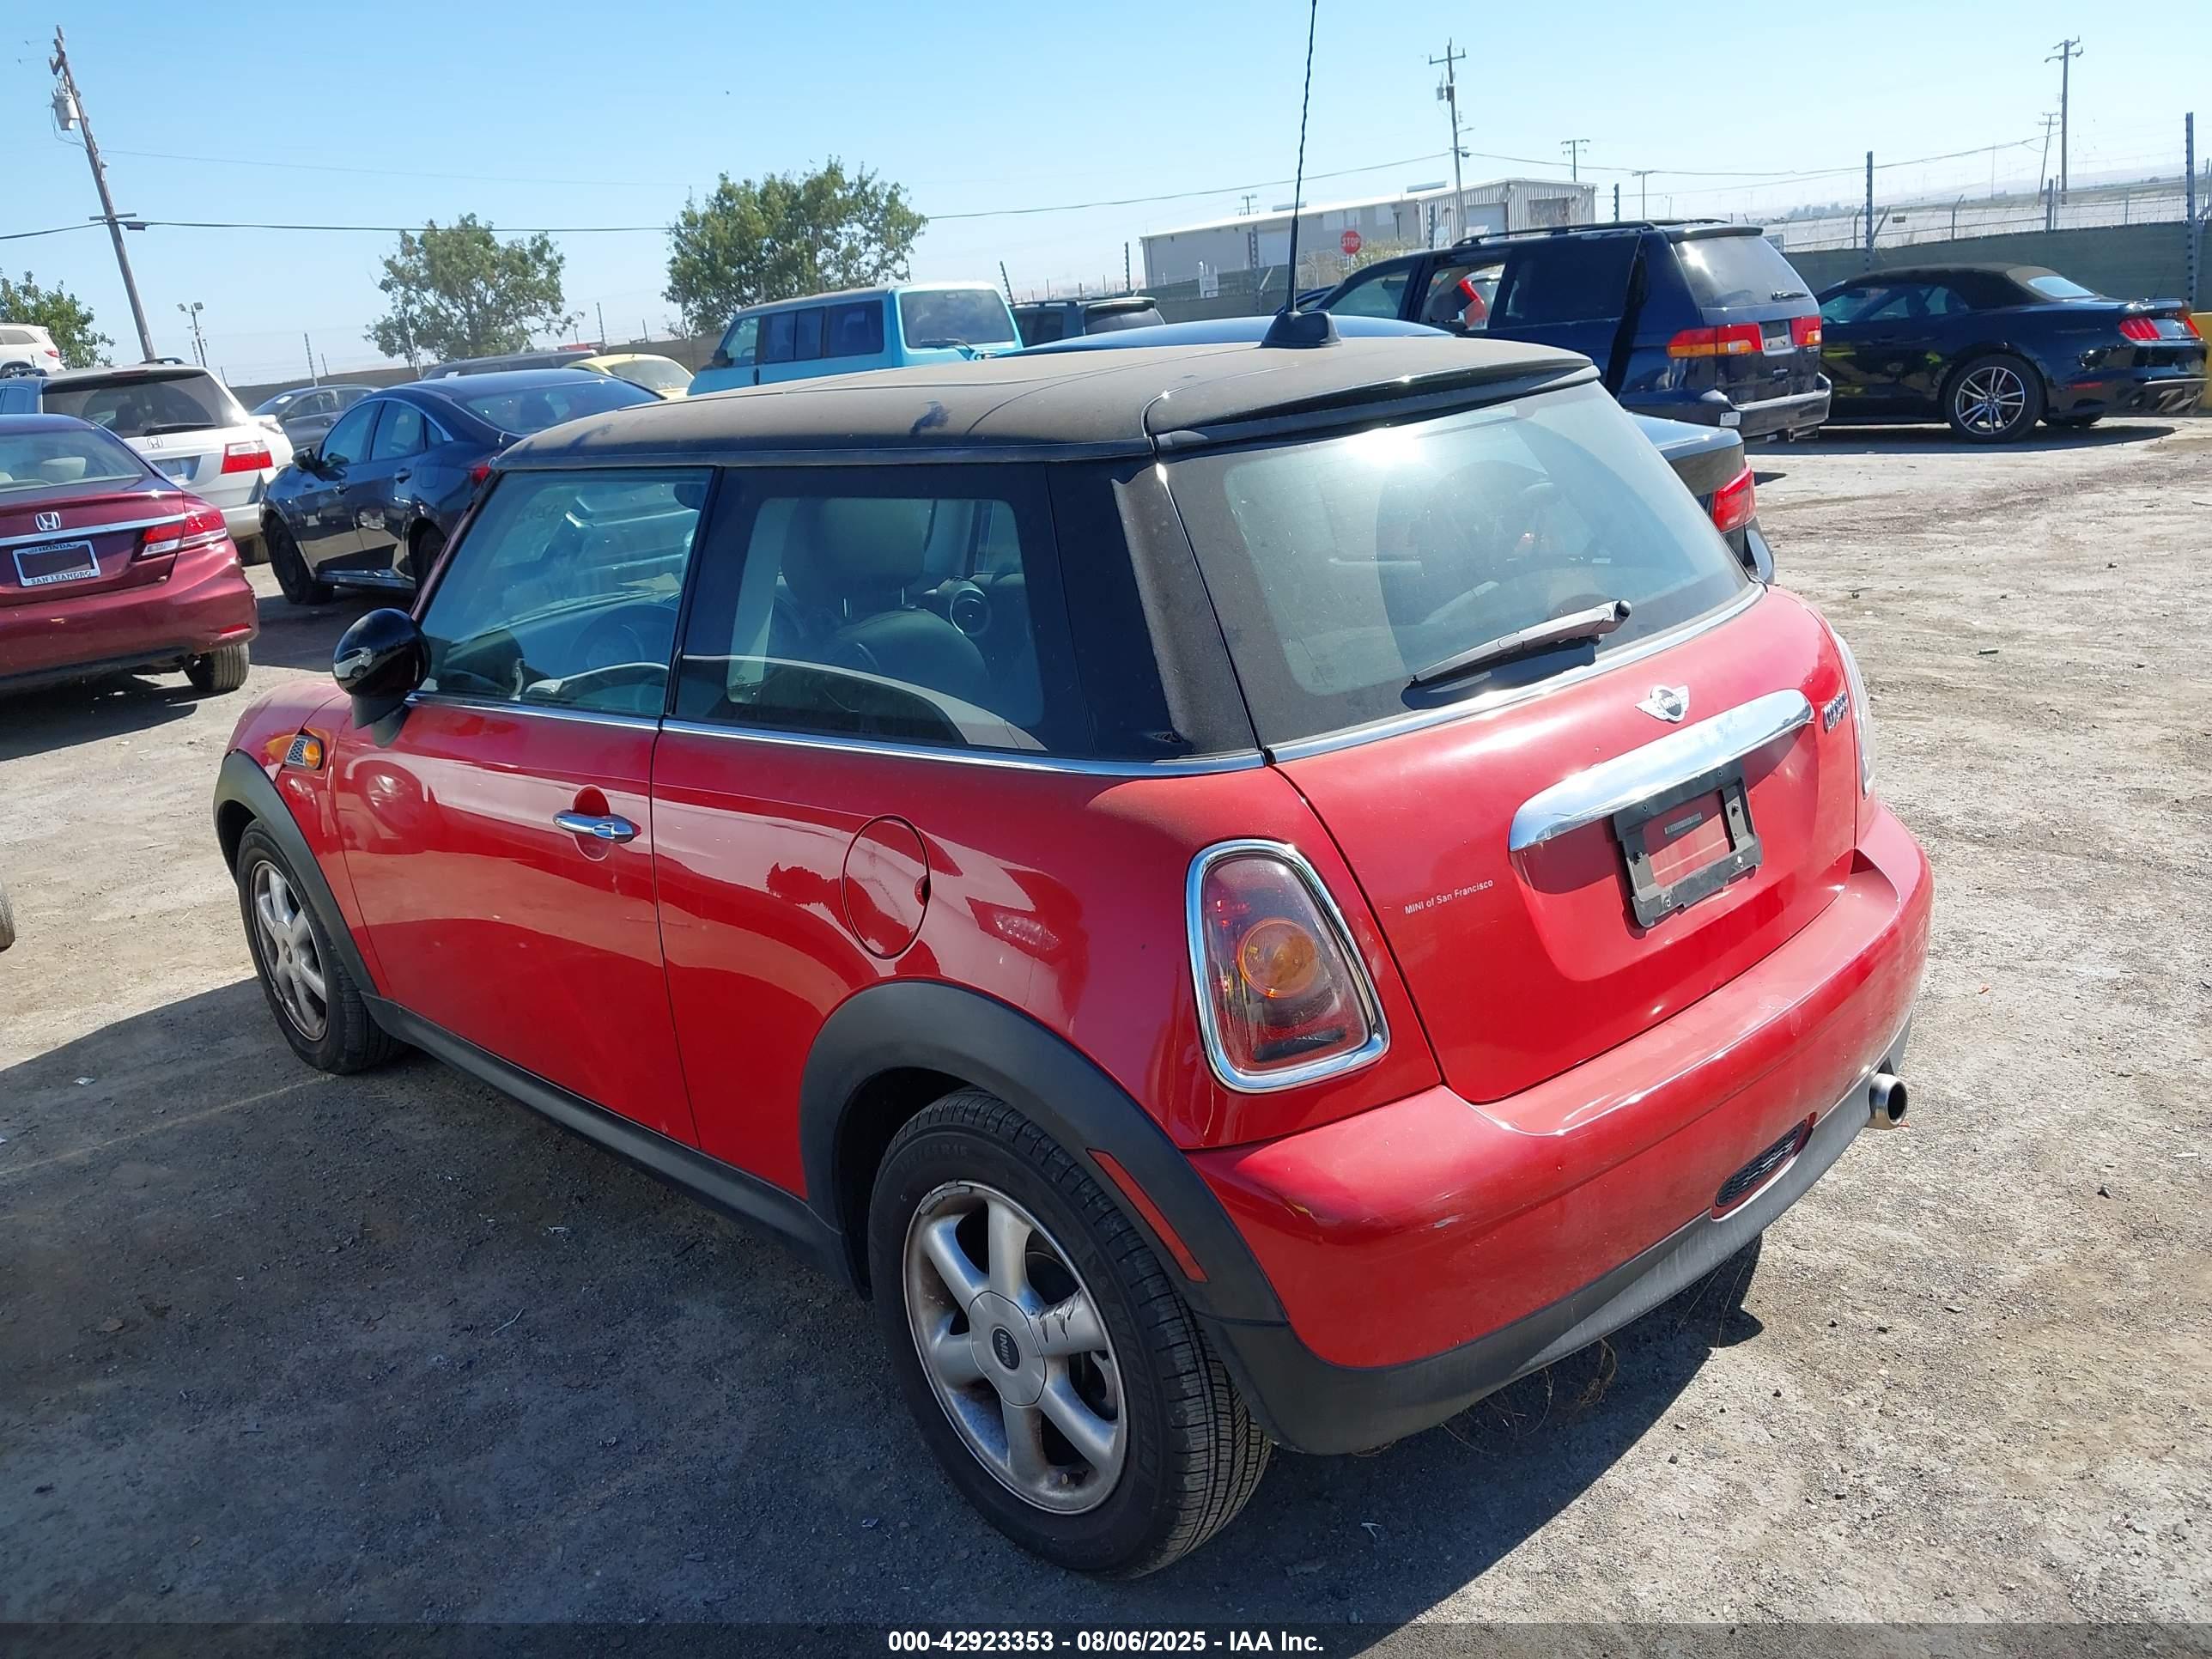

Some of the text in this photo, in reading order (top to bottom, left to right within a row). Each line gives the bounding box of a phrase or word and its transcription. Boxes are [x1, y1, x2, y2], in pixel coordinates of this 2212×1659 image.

[1341, 236, 1361, 247] STOP
[52, 570, 91, 582] LEANDRO
[1660, 696, 1677, 709] MINI
[1405, 879, 1494, 915] MINI of San Francisco
[1000, 1333, 1012, 1367] MINI
